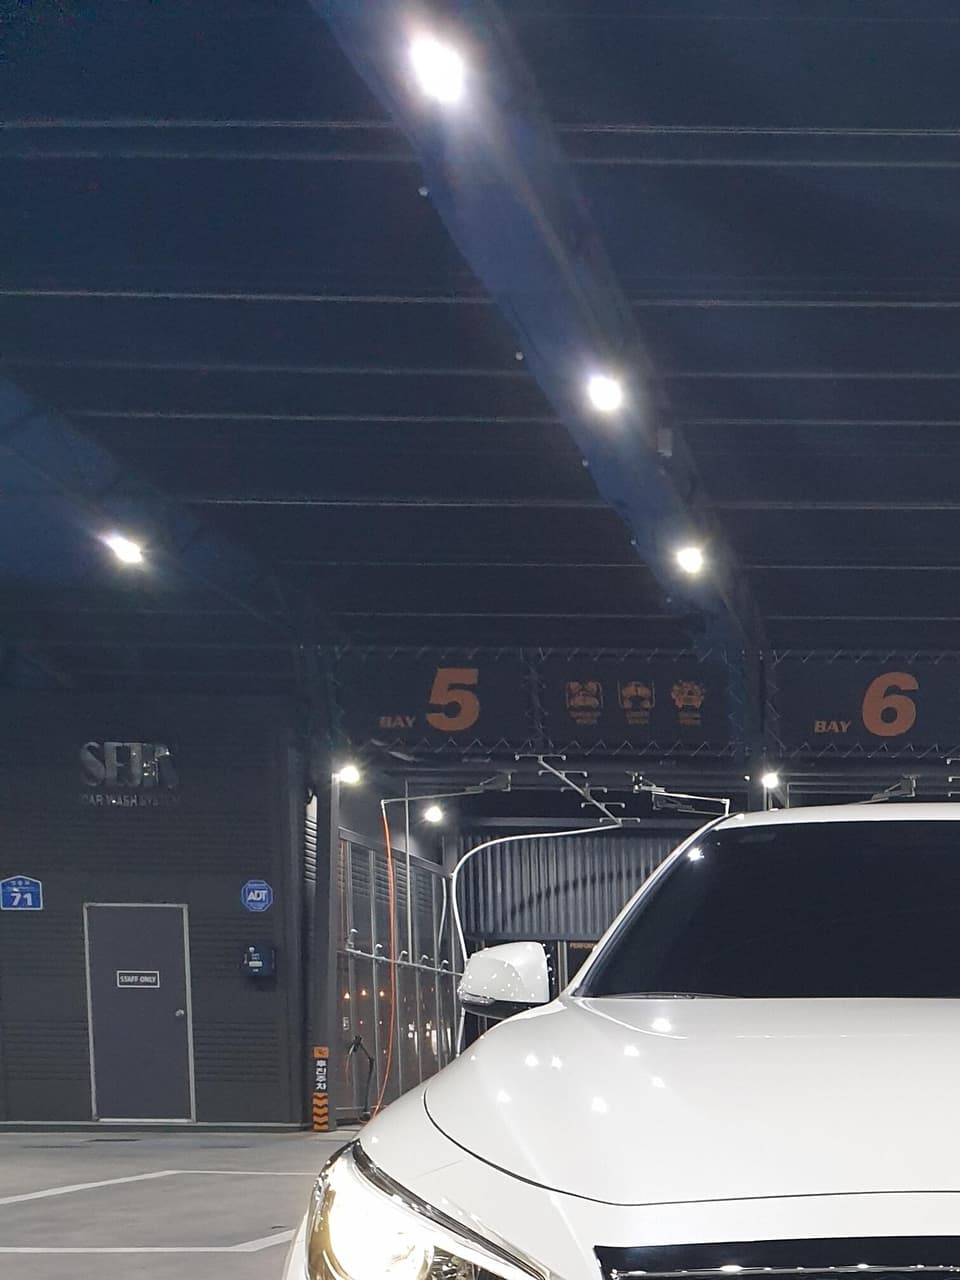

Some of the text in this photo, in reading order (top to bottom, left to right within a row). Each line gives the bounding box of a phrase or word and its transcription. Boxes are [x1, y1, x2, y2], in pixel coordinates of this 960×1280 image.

[426, 668, 480, 731] 5
[814, 671, 919, 736] BAY 6
[10, 892, 33, 906] 71
[247, 889, 268, 902] ADT
